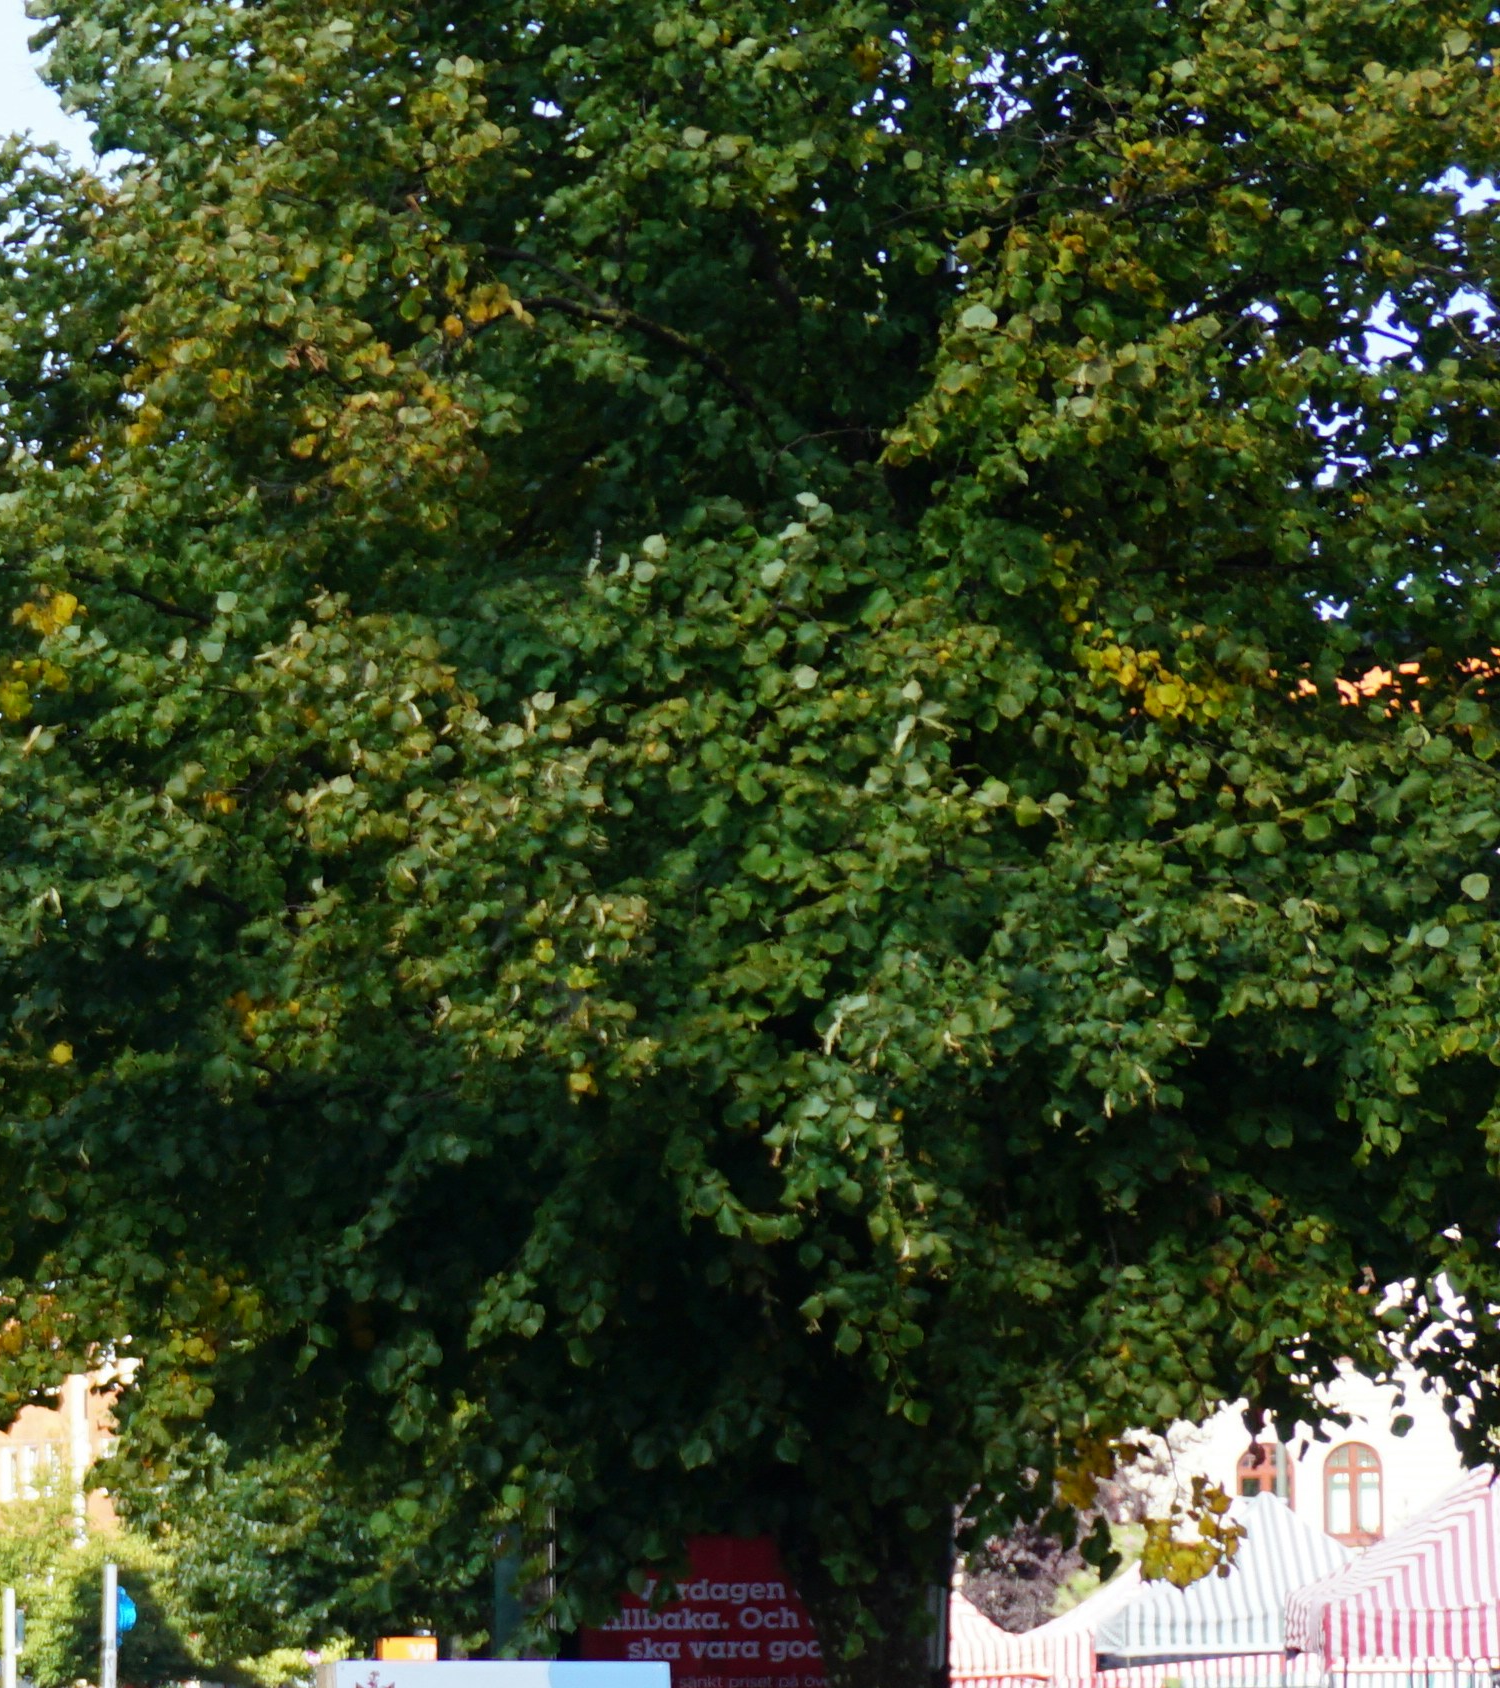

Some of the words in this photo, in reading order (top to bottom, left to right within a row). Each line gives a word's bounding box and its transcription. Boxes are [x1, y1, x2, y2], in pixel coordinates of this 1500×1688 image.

[739, 1607, 800, 1630] Och
[628, 1637, 681, 1660] ska
[688, 1639, 760, 1660] vara
[679, 1675, 722, 1688] sänkt
